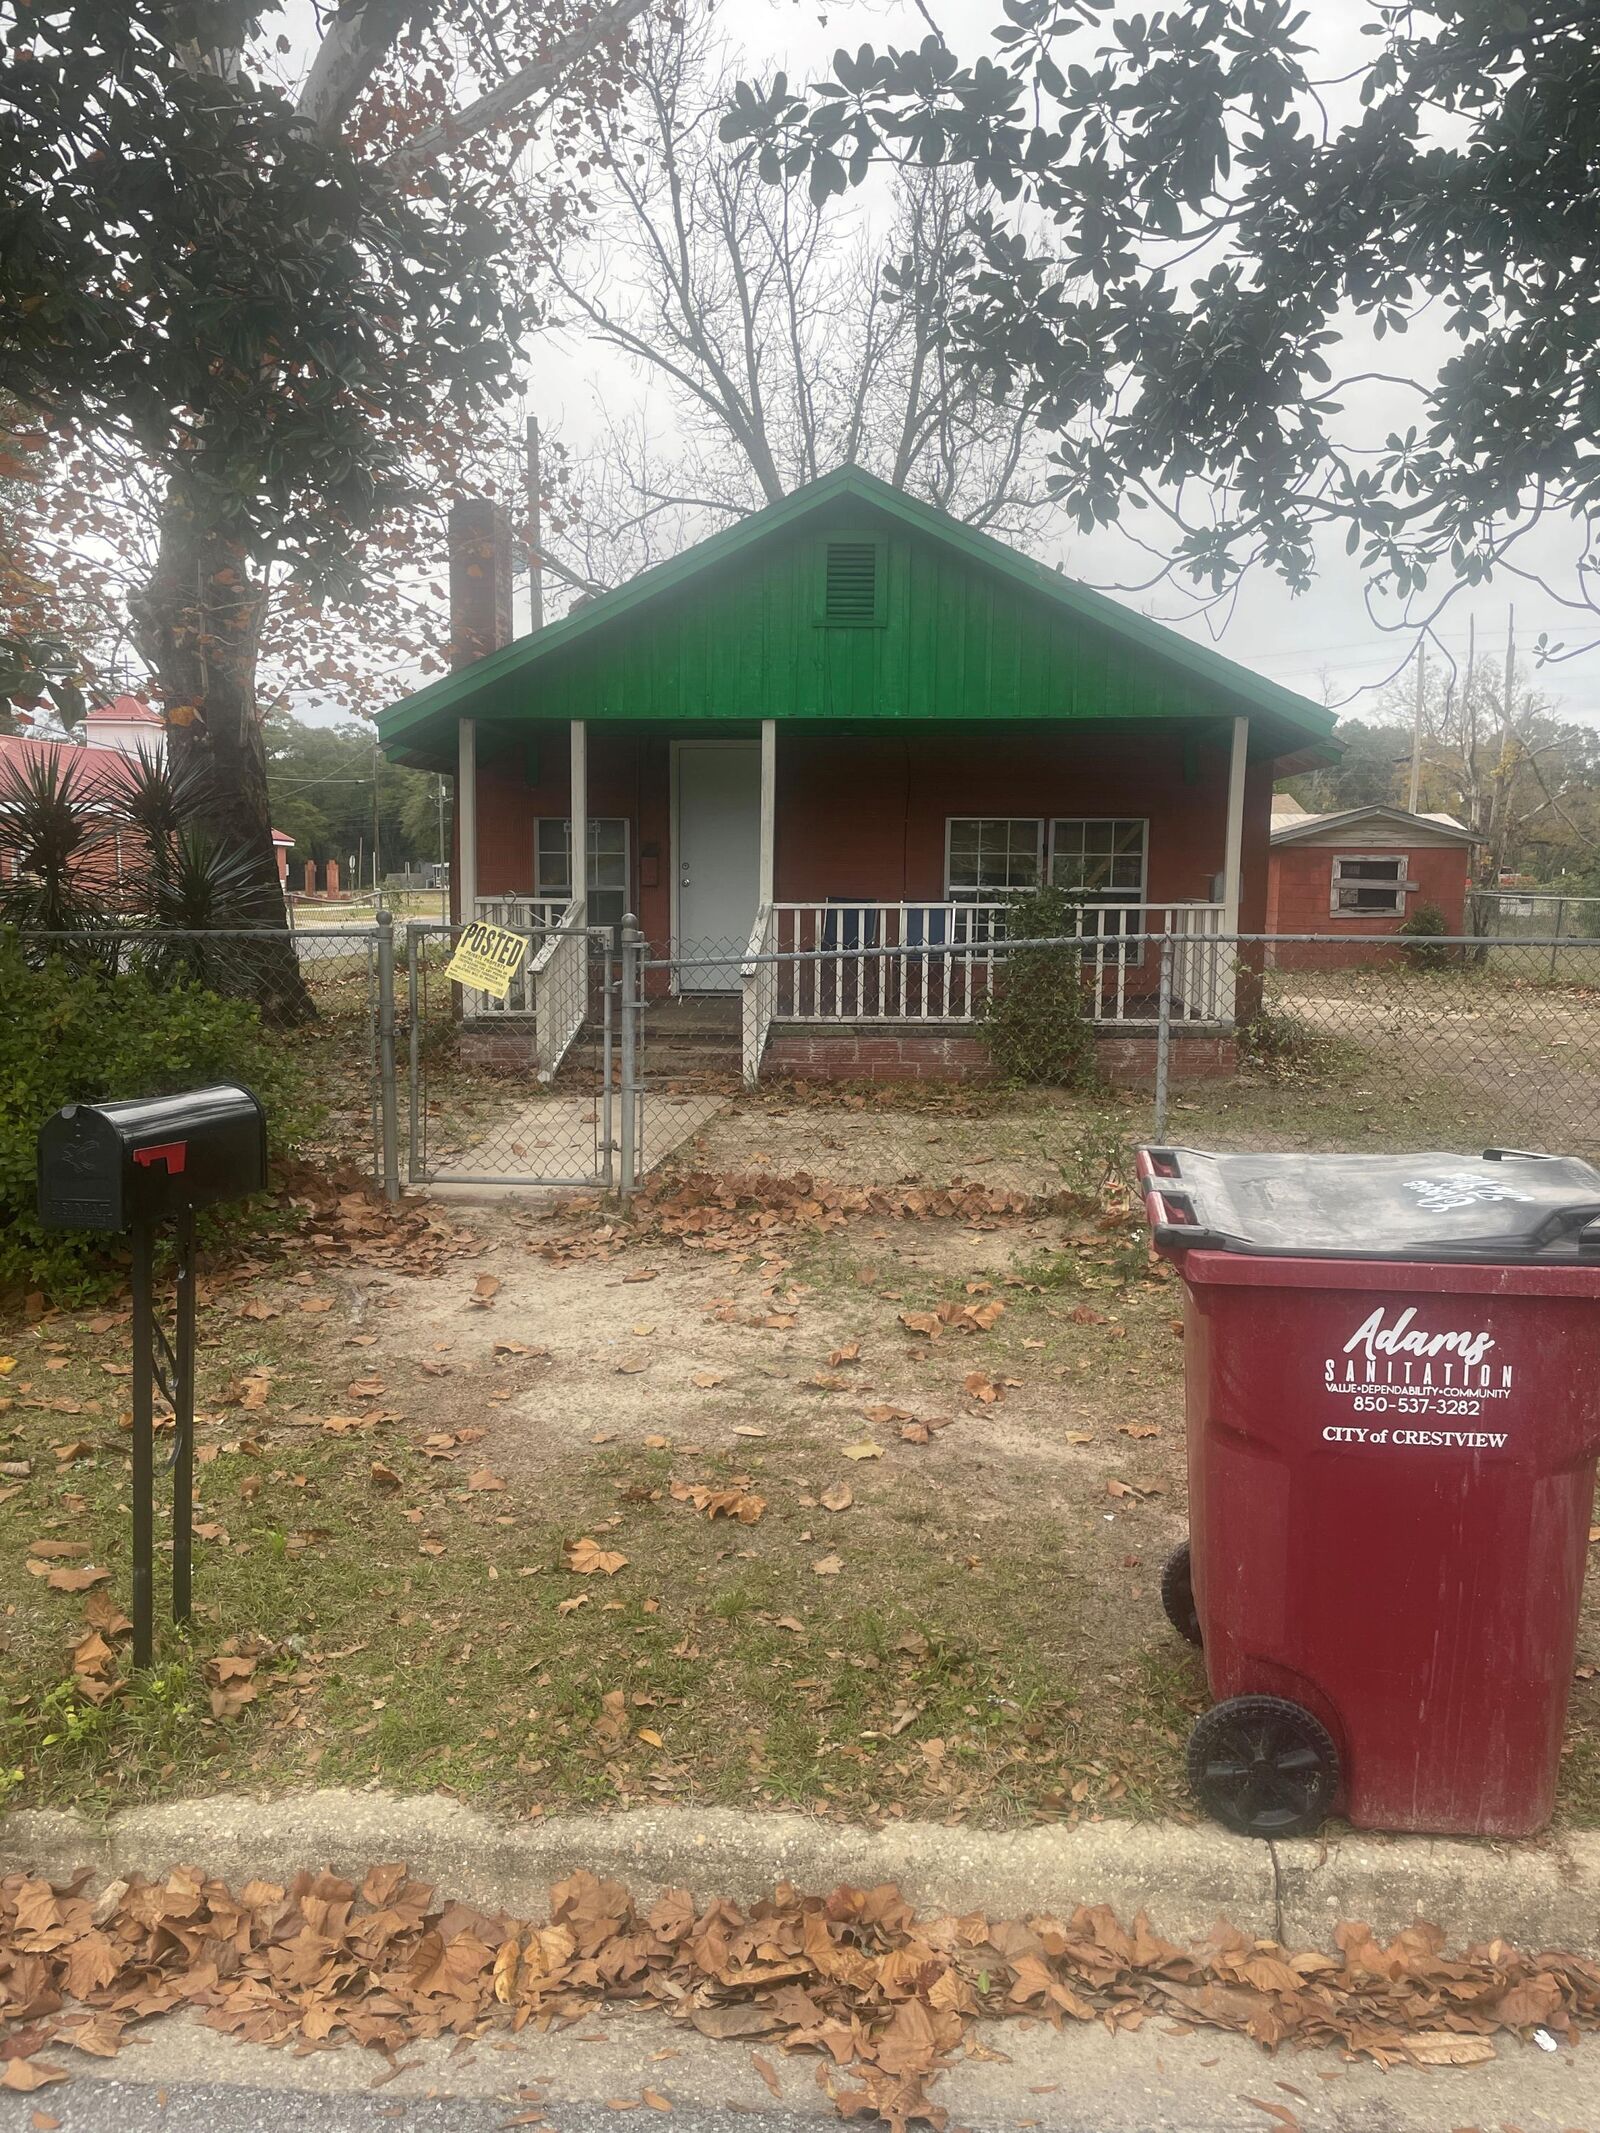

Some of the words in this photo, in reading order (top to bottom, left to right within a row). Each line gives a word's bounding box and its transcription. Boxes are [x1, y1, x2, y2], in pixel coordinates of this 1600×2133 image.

[461, 923, 524, 967] POSTED
[1343, 1307, 1495, 1366] Adams
[1324, 1359, 1512, 1388] SANITATION
[1353, 1396, 1480, 1415] 850-537-3282
[1322, 1426, 1370, 1442] CITY
[1370, 1430, 1389, 1444] of
[1392, 1430, 1508, 1448] CRESTVIEW
